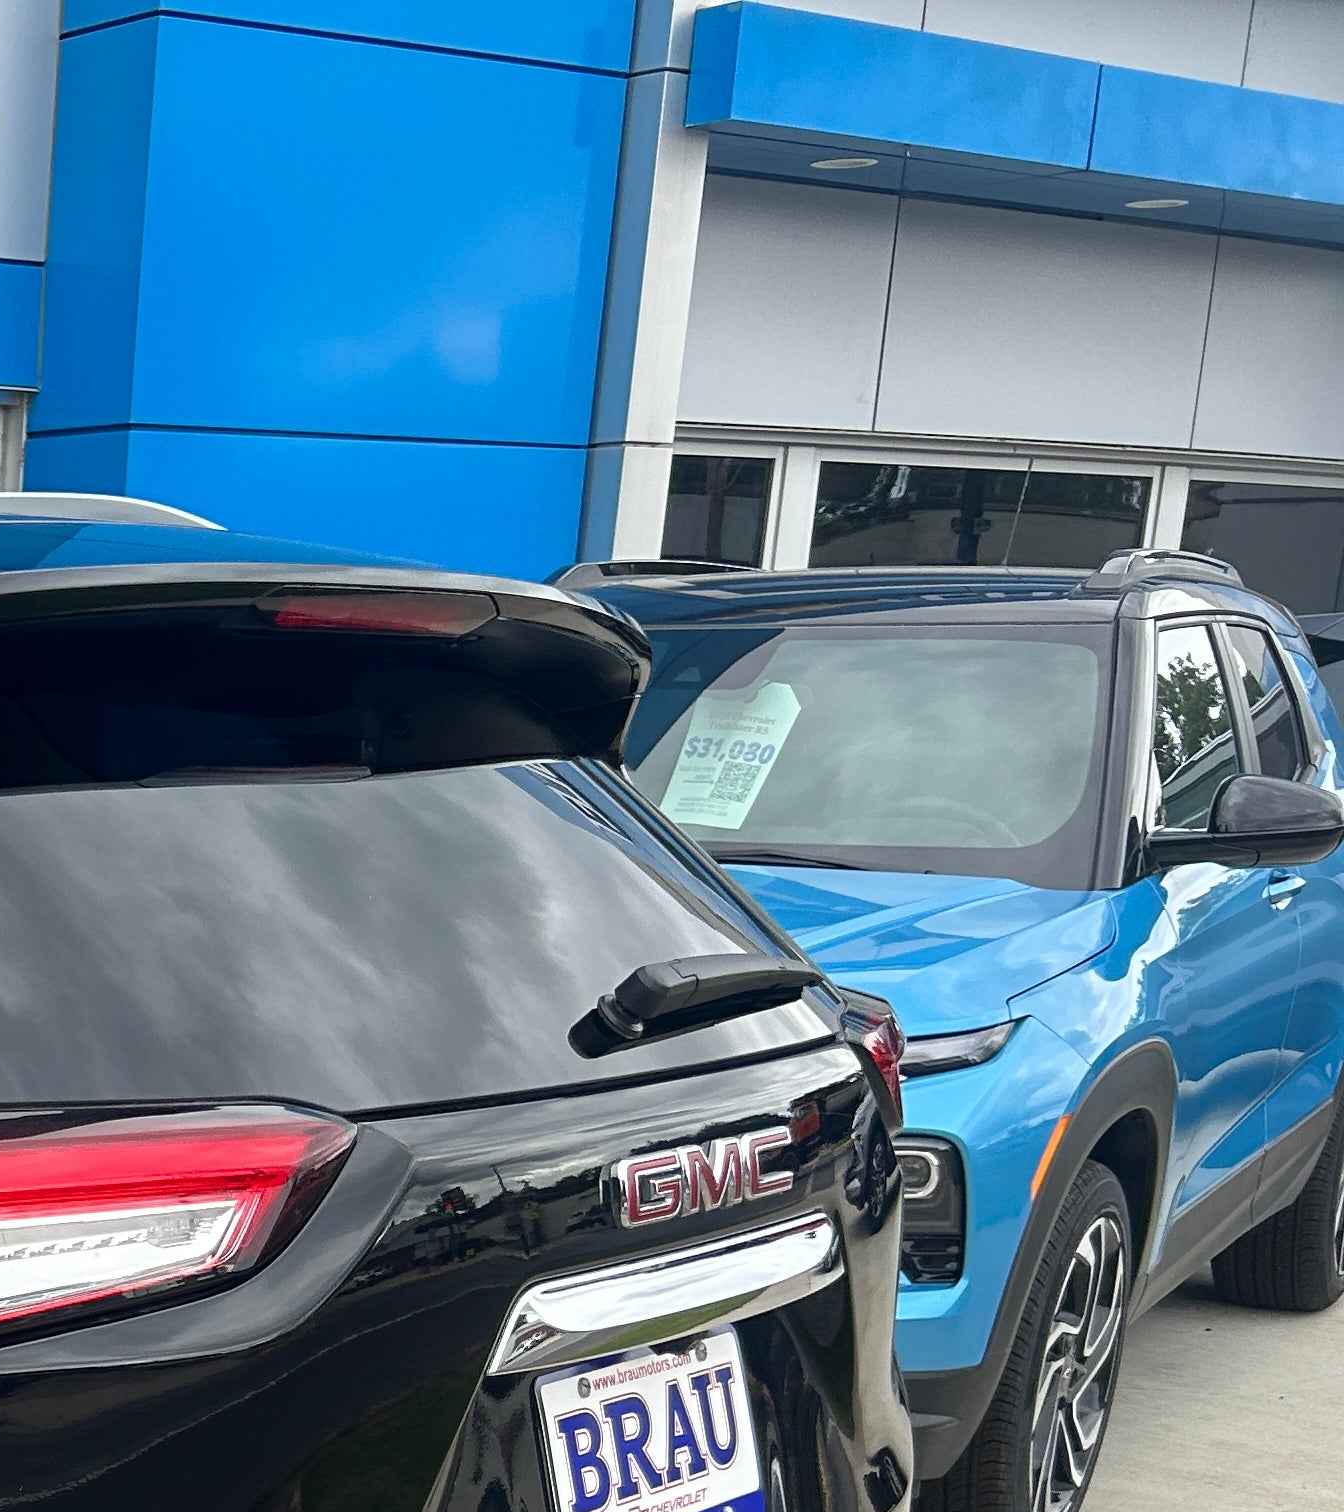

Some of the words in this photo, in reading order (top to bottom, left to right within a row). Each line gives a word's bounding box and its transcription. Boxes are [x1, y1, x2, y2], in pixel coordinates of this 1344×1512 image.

[684, 735, 776, 765] $31,080
[618, 1125, 794, 1229] GMC
[592, 1353, 692, 1391] www.braumotors.com
